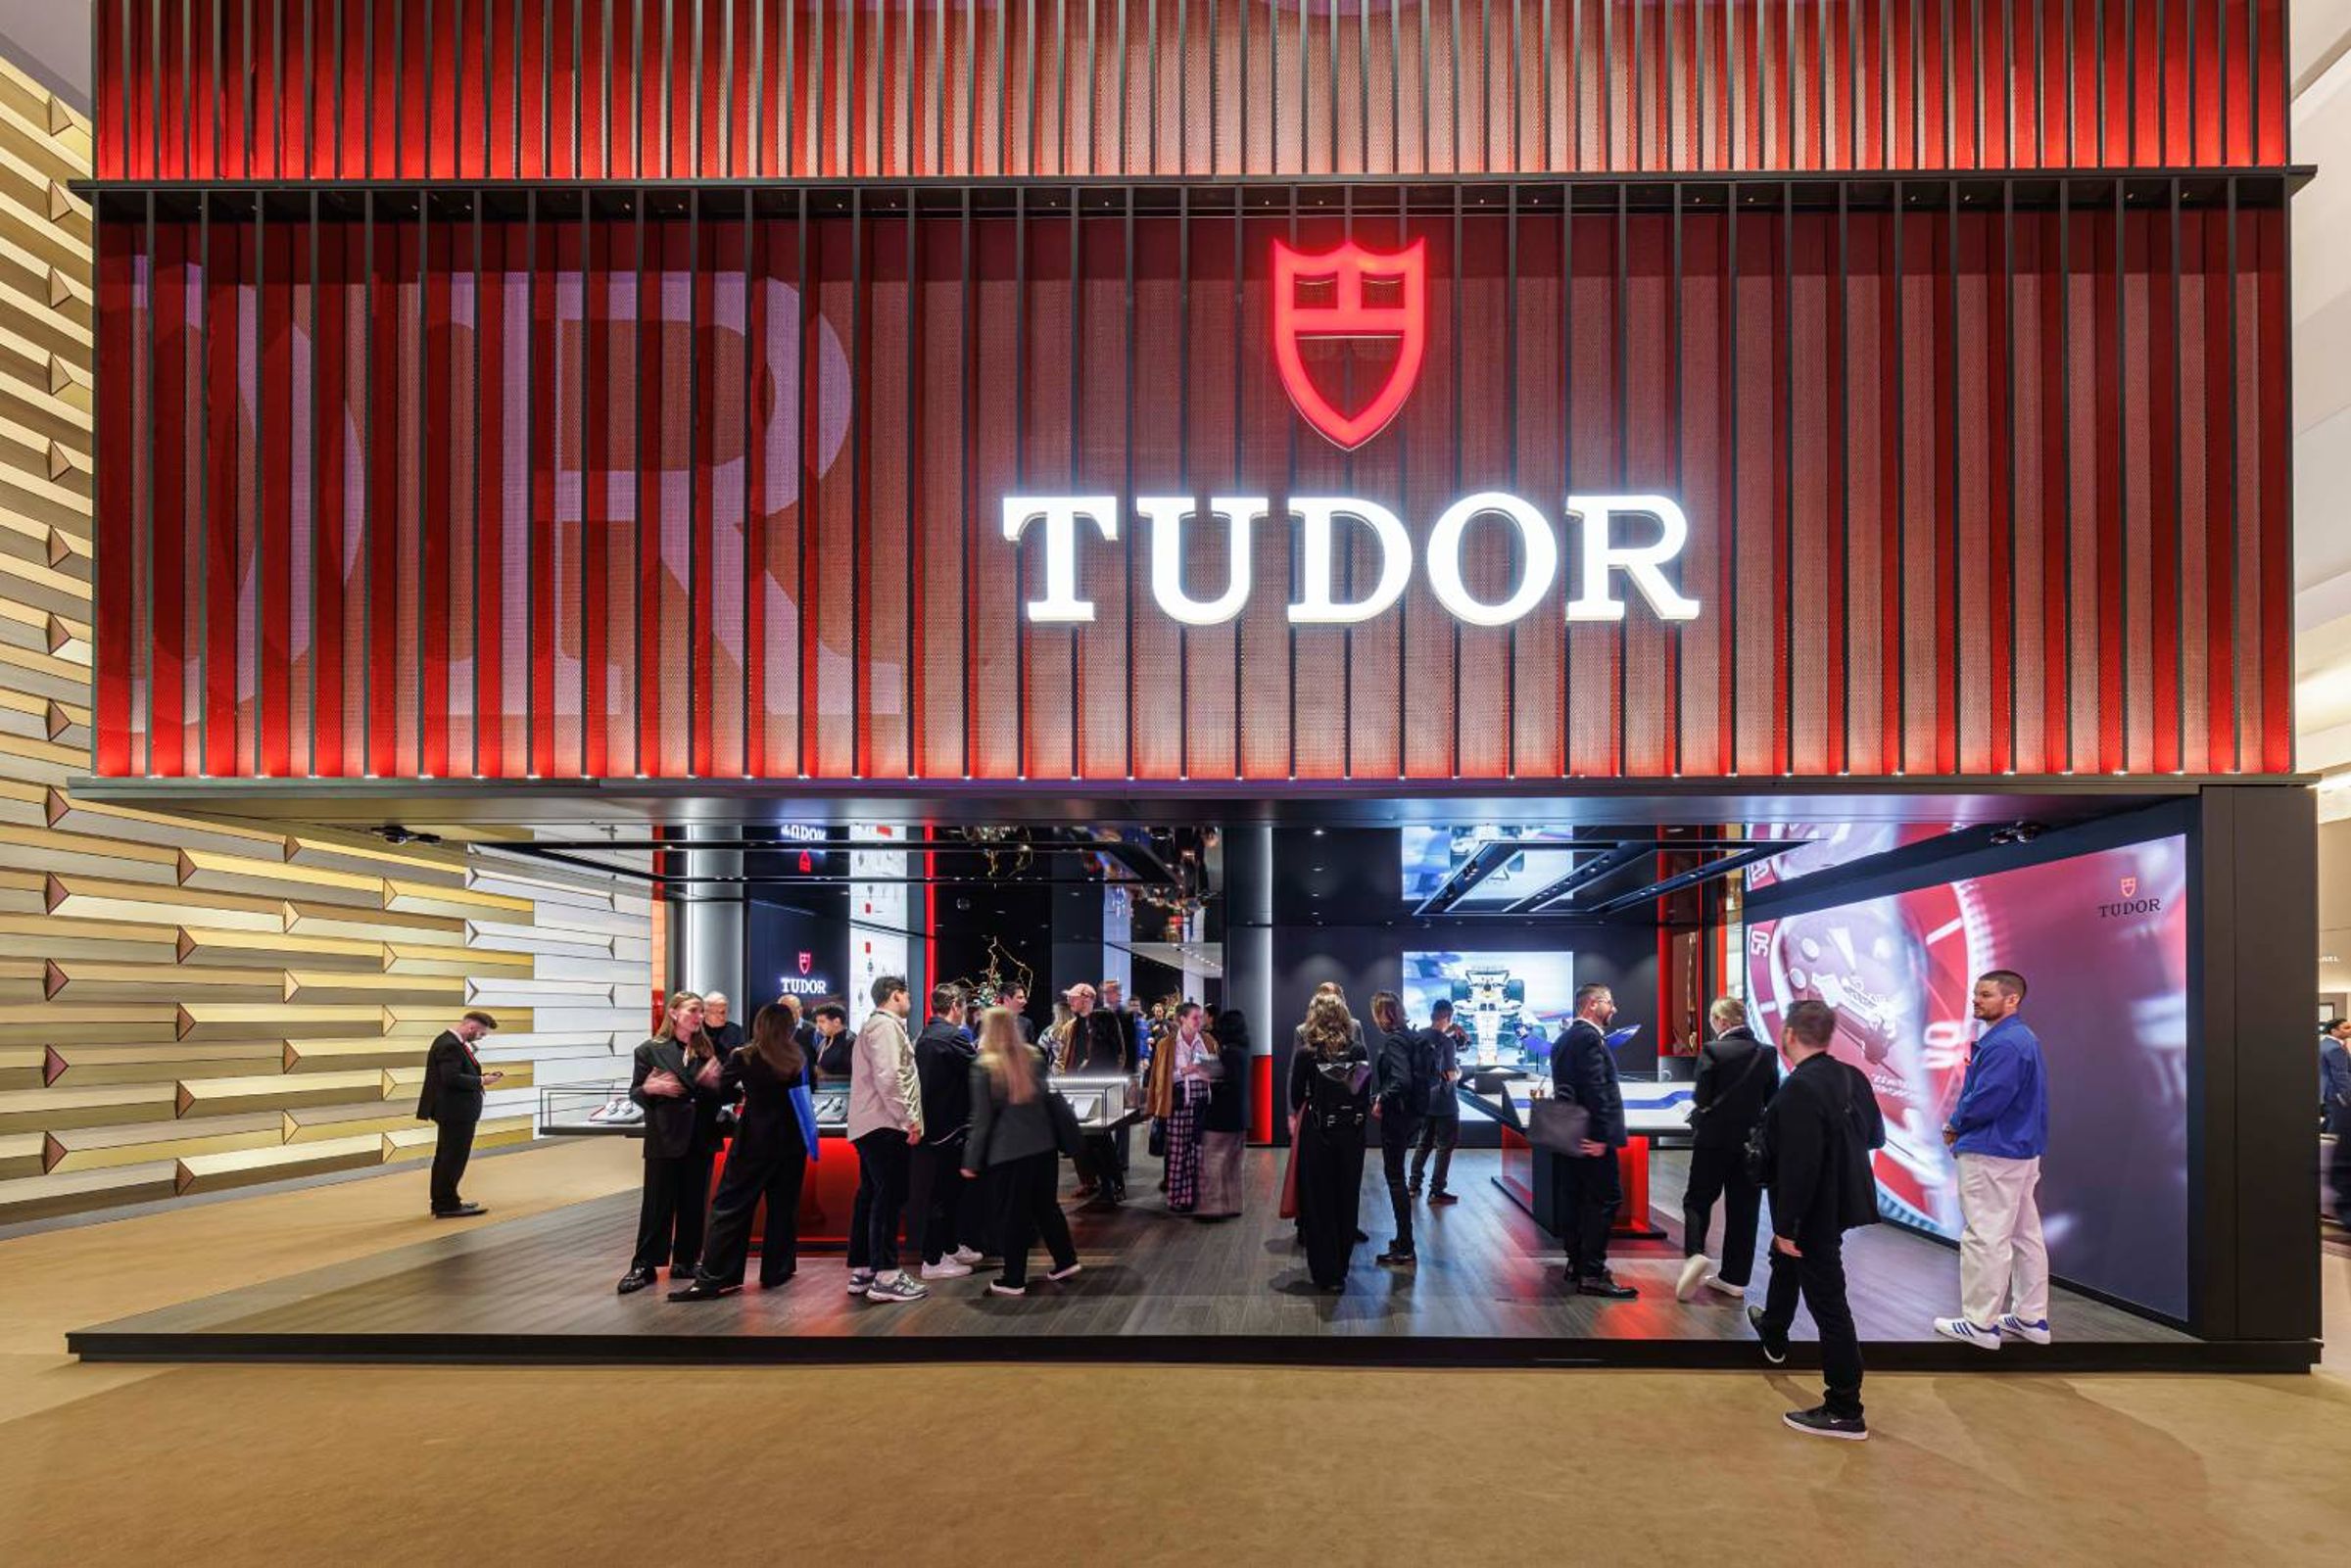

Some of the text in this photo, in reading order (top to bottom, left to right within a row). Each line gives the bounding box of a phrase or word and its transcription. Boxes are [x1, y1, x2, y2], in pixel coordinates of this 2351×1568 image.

[1002, 492, 1701, 625] TUDOR
[2098, 898, 2161, 918] TUDOR
[1751, 930, 1770, 957] 50
[781, 978, 826, 993] TUDOR
